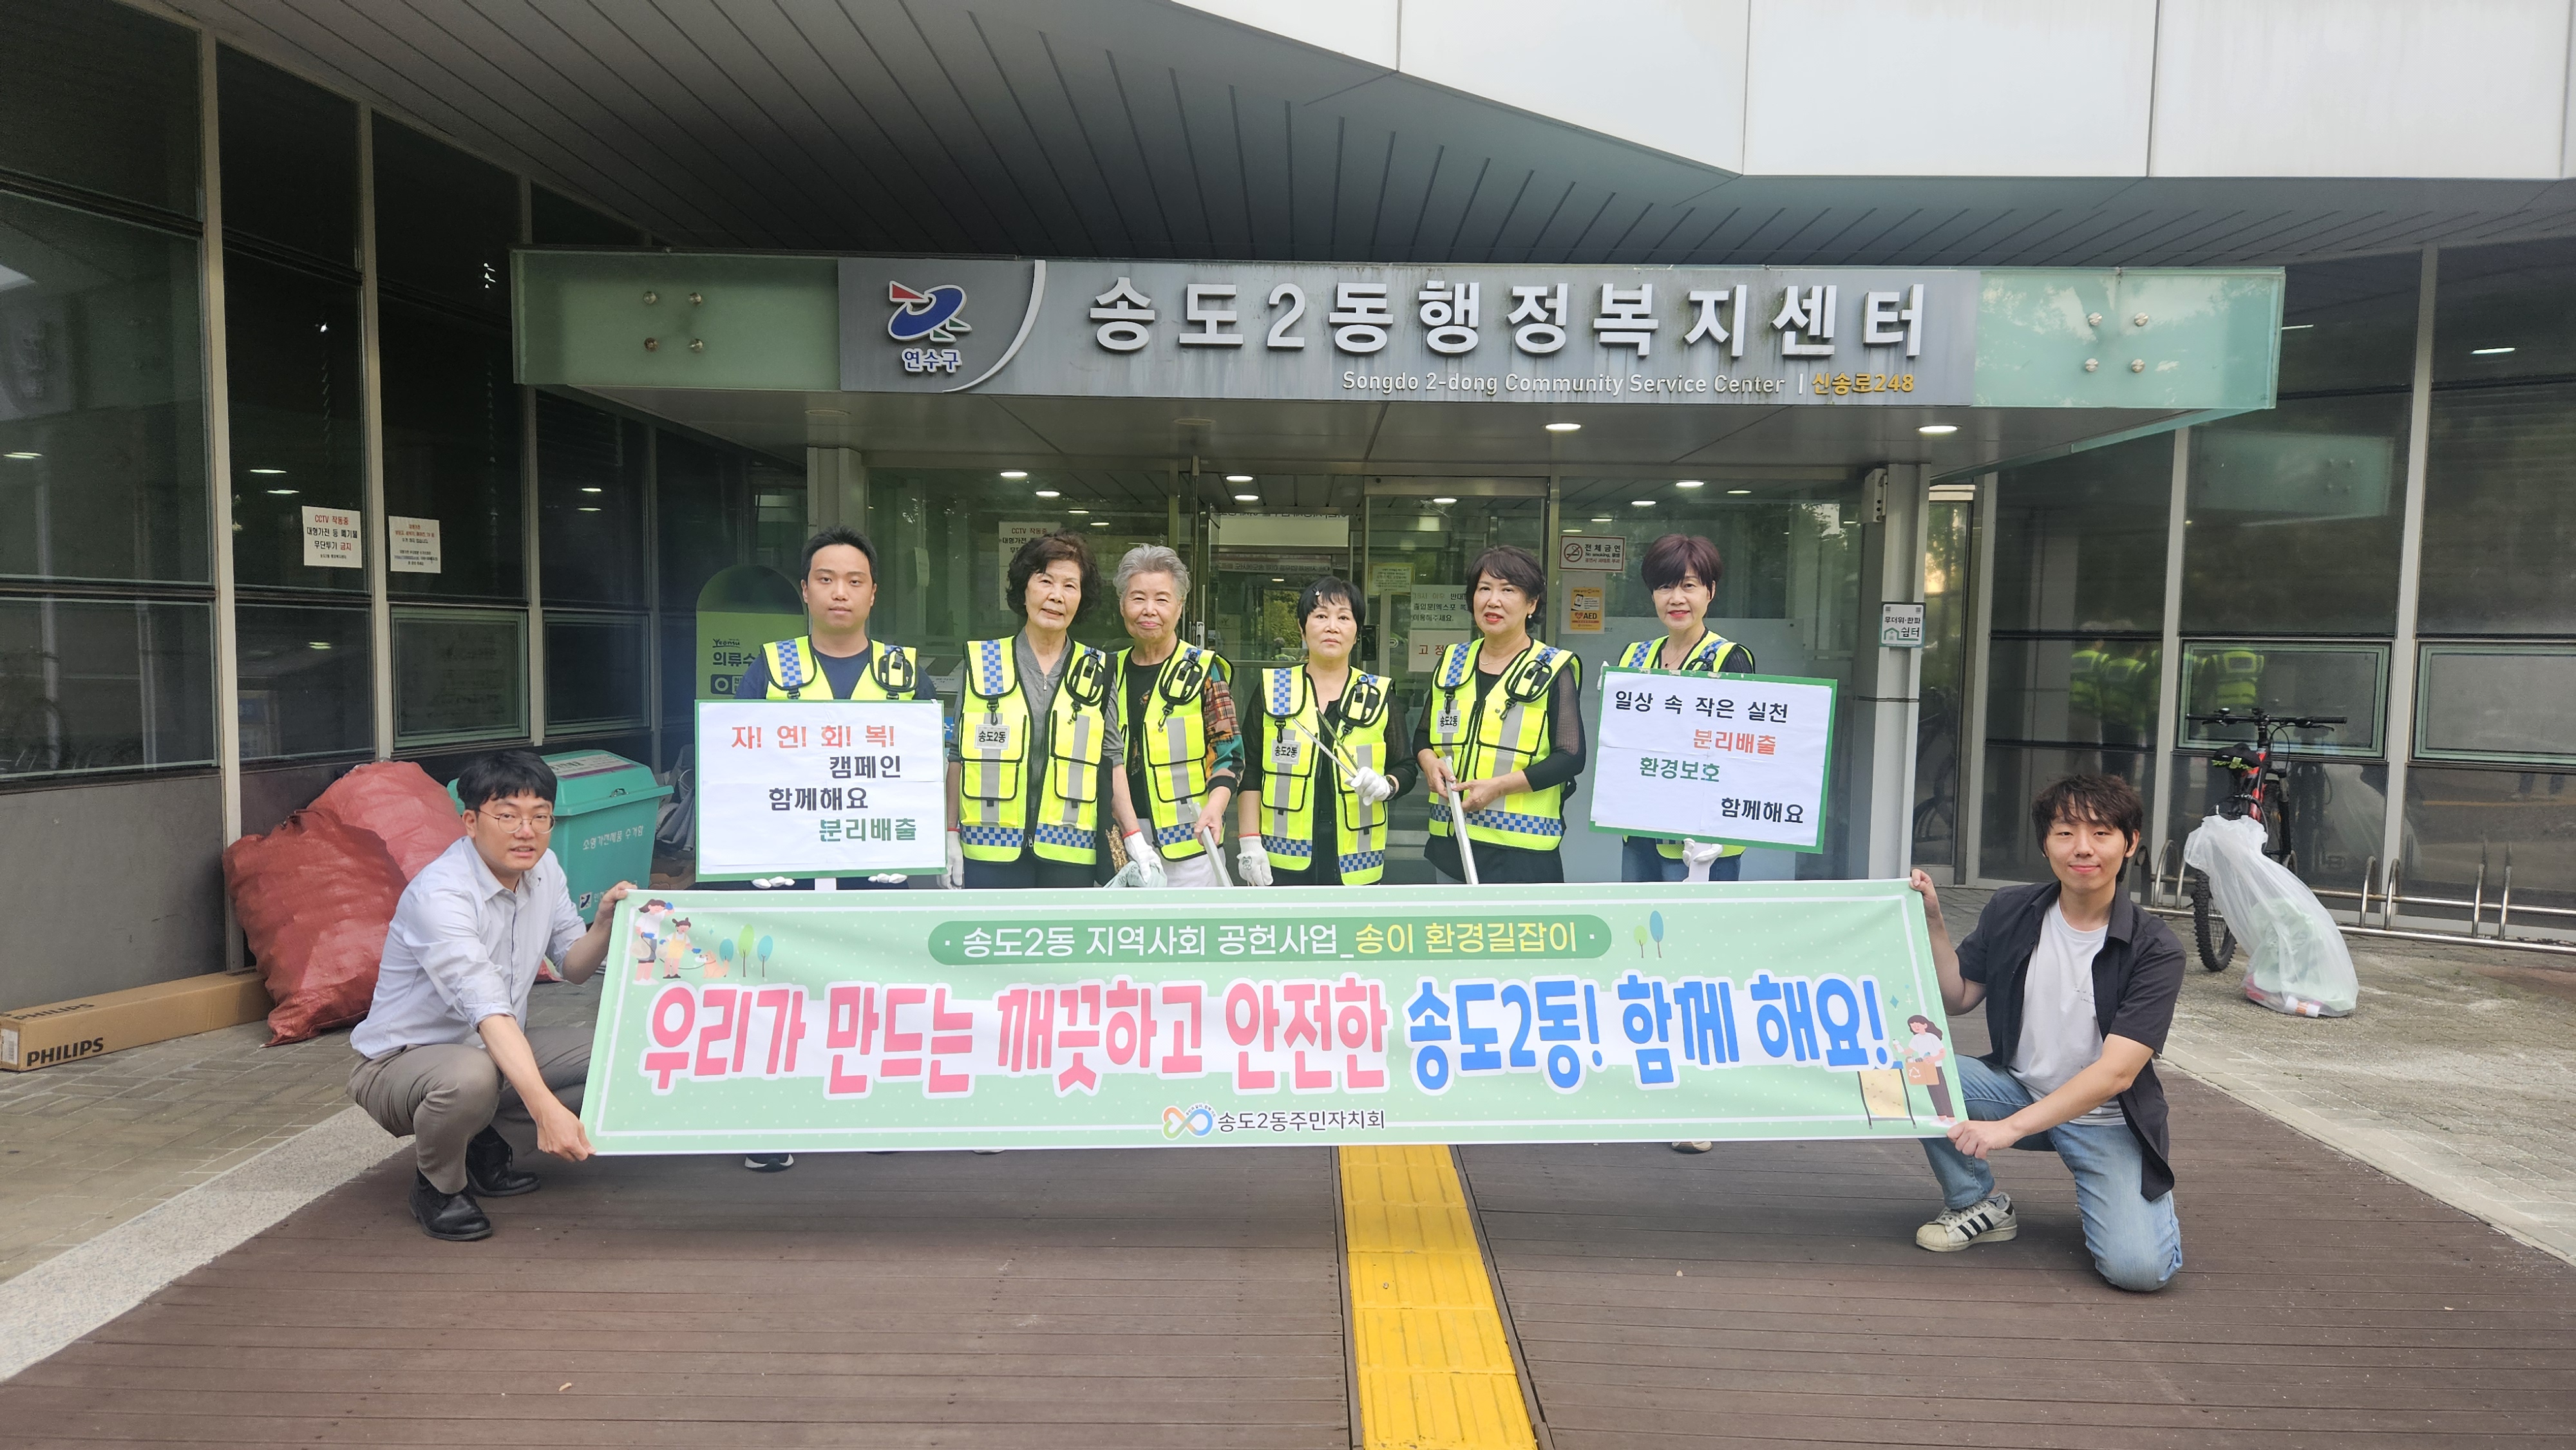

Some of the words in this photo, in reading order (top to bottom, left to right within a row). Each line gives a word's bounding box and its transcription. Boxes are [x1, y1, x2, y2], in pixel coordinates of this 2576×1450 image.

[1090, 277, 1924, 357] 송도2동행정복지센터
[903, 350, 960, 372] 연수구
[1343, 371, 1418, 394] Songdo
[1426, 372, 1498, 395] 2-dong
[1506, 373, 1623, 397] Community
[1630, 374, 1706, 393] Service
[1714, 375, 1785, 393] Center
[1812, 373, 1915, 395] 신송로248
[314, 514, 329, 523] CCTV
[332, 516, 349, 525] 작동중
[307, 527, 330, 537] 대형가전
[332, 529, 339, 537] 등
[341, 529, 358, 539] 폐기물
[314, 541, 337, 550] 무단투기
[340, 542, 352, 551] 금지
[1901, 626, 1920, 637] 쉼터
[1615, 691, 1653, 712] 일상
[1664, 695, 1682, 715] 속
[1695, 697, 1734, 719] 작은
[1747, 701, 1788, 724] 실천
[1440, 715, 1458, 728] 송도2동
[731, 726, 762, 749] 자!
[777, 725, 807, 748] 연!
[820, 725, 851, 748] 회!
[865, 725, 895, 748] 복!
[978, 730, 1006, 744] 송도2동
[1693, 729, 1776, 755] 분리배출
[1274, 745, 1298, 758] 송도2동
[829, 755, 901, 779] 캠페인
[1639, 757, 1720, 783] 환경보호
[768, 787, 868, 811] 함께해요
[1721, 797, 1804, 824] 함께해요
[625, 825, 644, 840] 수거함
[819, 818, 917, 842] 분리배출
[962, 925, 1075, 957] 송도2동
[1086, 923, 1206, 957] 지역사회
[1425, 919, 1577, 954] 환경길잡이
[13, 1003, 95, 1021] PHILIPS
[644, 985, 808, 1091] 우리가
[825, 985, 974, 1095] 만드는
[997, 979, 1203, 1093] 깨끗하고
[1225, 976, 1388, 1091] 안전한
[1406, 979, 1601, 1091] 송도2동!
[1617, 974, 1739, 1084] 함께
[1750, 972, 1889, 1068] 해요!
[26, 1037, 104, 1067] PHILIPS
[1217, 1109, 1385, 1133] 송도2동주민자치회
